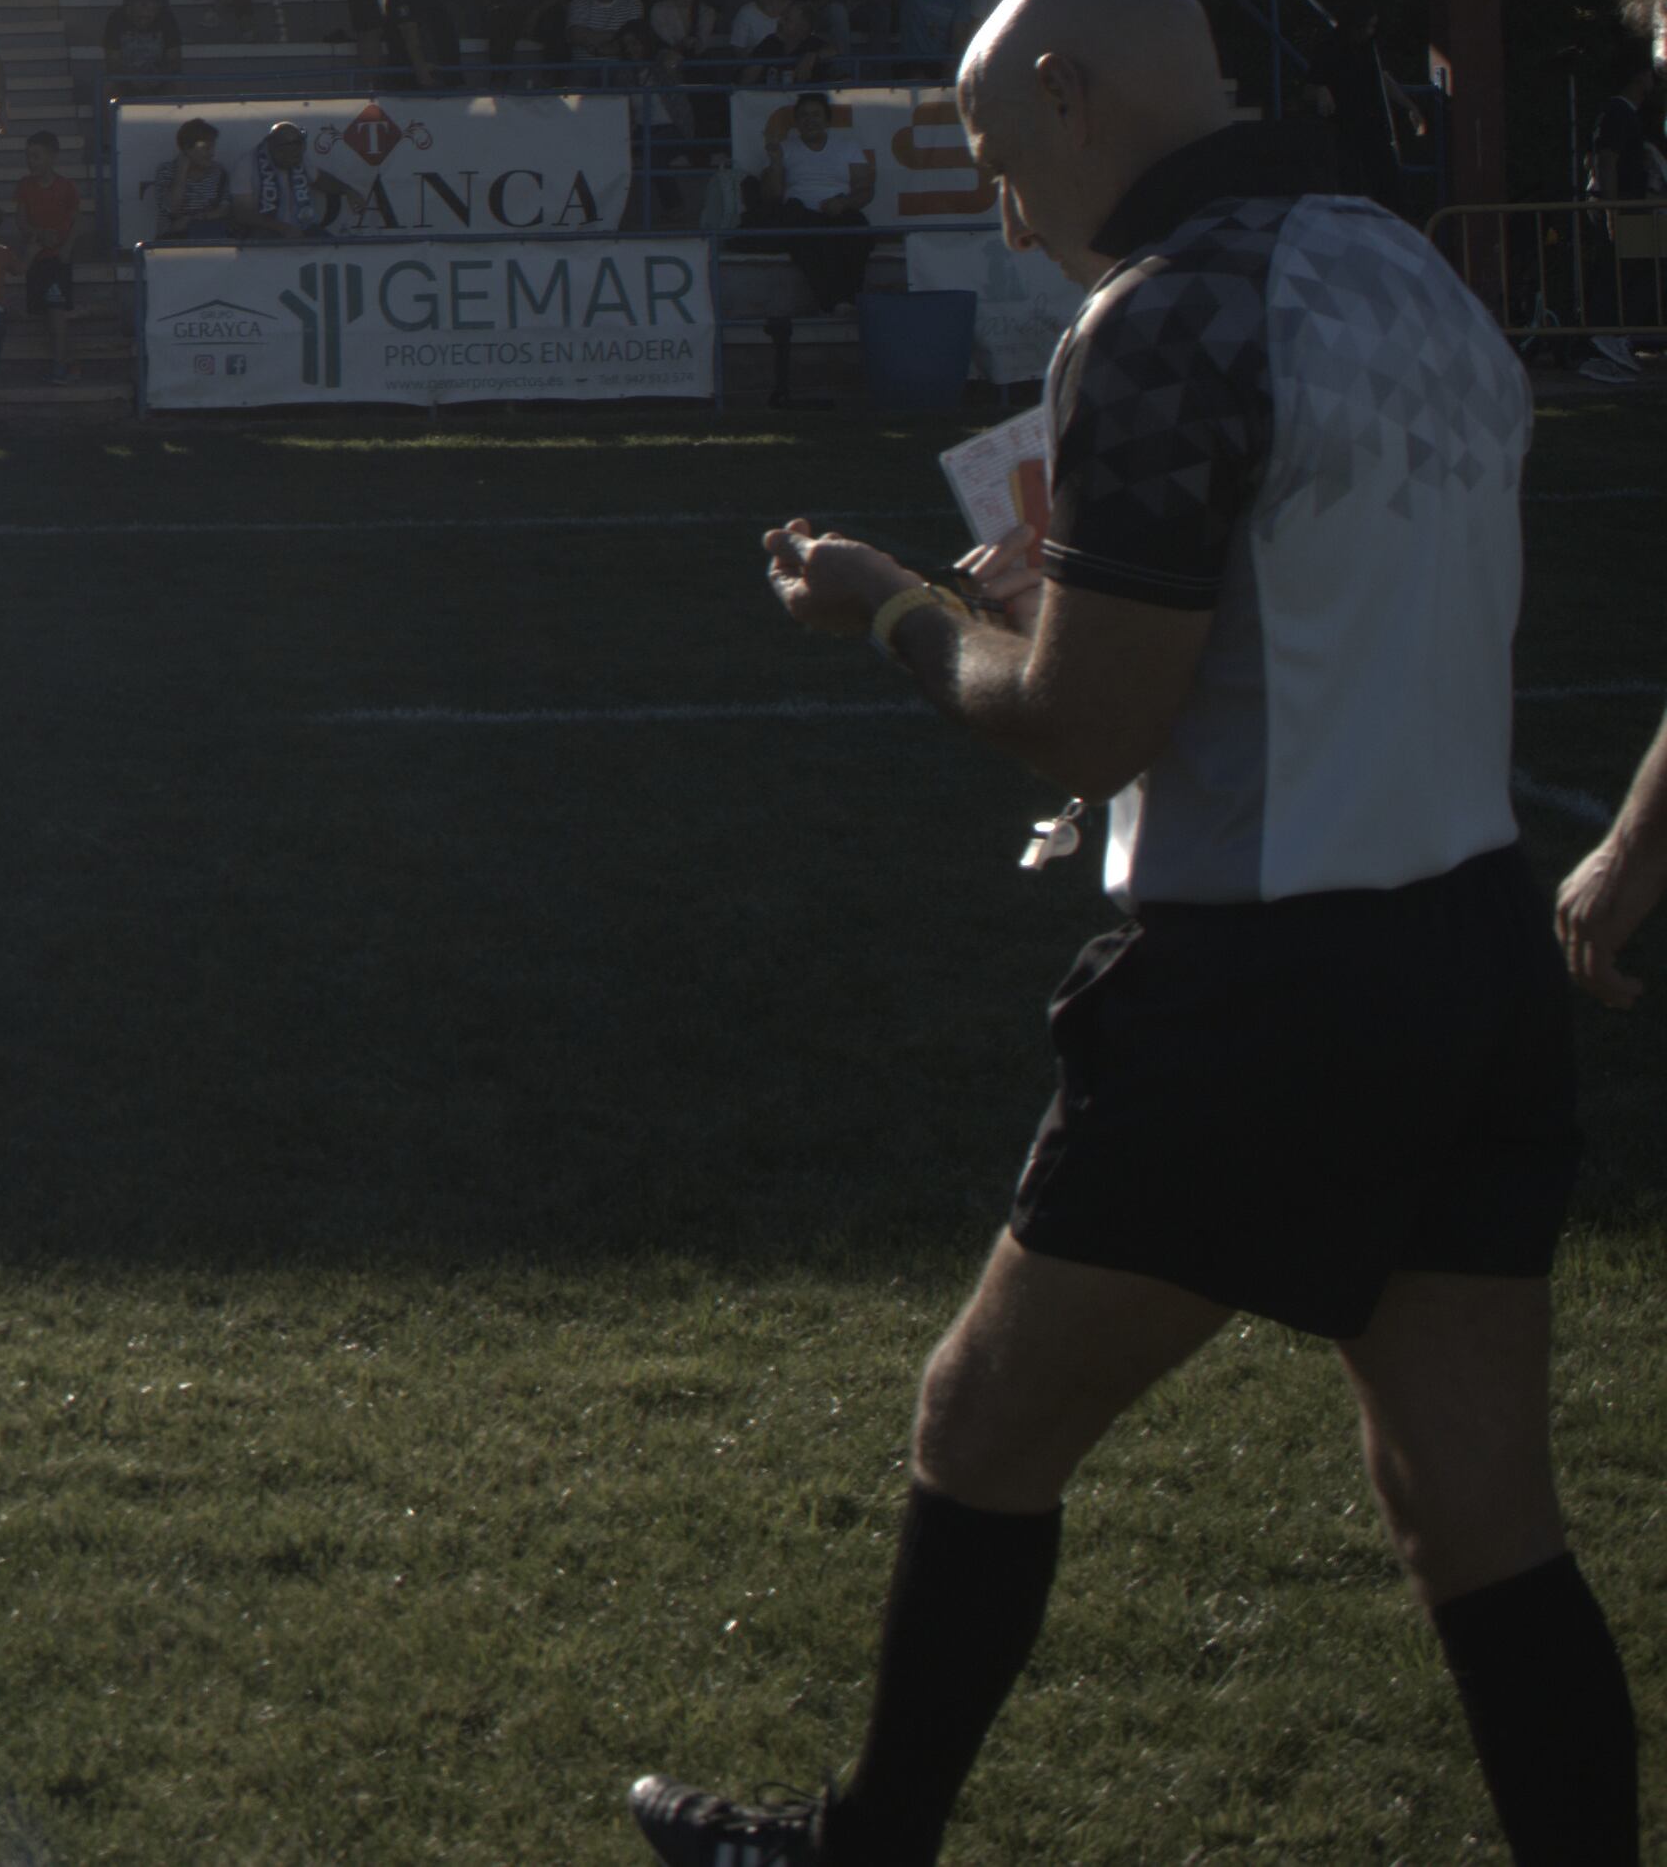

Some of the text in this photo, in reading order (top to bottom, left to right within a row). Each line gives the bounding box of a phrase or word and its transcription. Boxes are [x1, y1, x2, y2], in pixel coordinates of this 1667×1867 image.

[378, 255, 697, 332] GEMAR
[173, 320, 263, 339] GERAYCA
[384, 338, 694, 368] PROYECTOS EN MADERA
